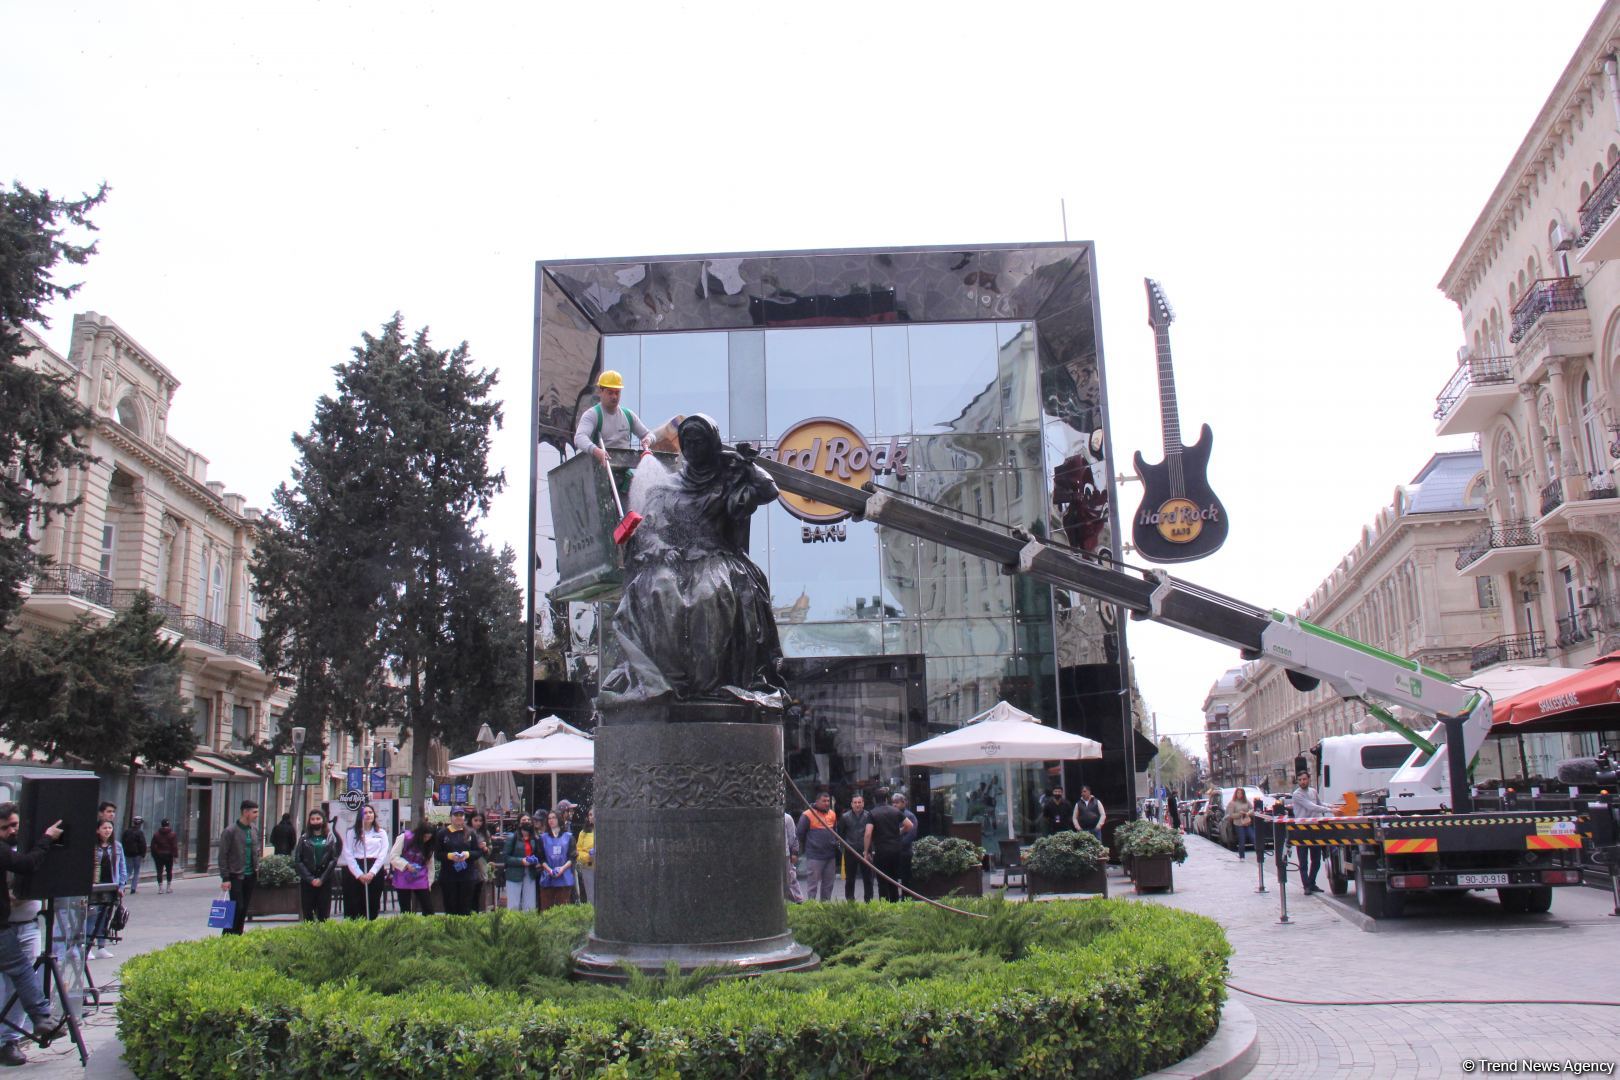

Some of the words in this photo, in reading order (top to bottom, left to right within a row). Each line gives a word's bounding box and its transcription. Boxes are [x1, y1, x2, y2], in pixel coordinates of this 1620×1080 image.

[751, 437, 822, 473] ard
[826, 436, 908, 480] Rock
[1139, 506, 1179, 525] Hard
[1180, 504, 1219, 525] Rock
[801, 525, 847, 543] BAKU
